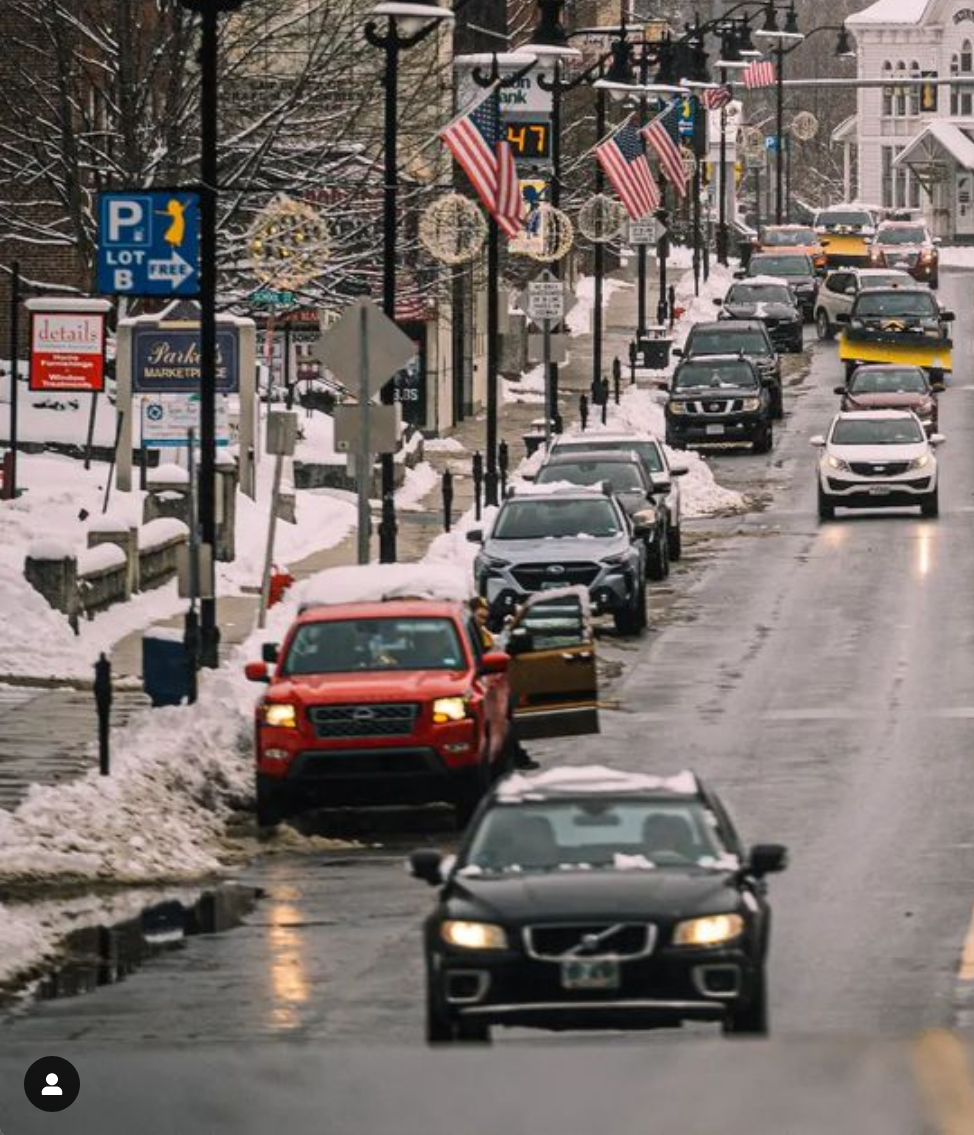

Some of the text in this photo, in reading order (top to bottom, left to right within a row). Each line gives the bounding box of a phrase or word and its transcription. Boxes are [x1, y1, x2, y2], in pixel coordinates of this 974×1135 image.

[500, 93, 528, 104] ank
[506, 125, 546, 152] 47
[108, 200, 143, 242] P
[106, 250, 145, 265] LOT
[114, 269, 133, 290] B
[150, 264, 187, 276] FREE
[39, 319, 98, 341] details
